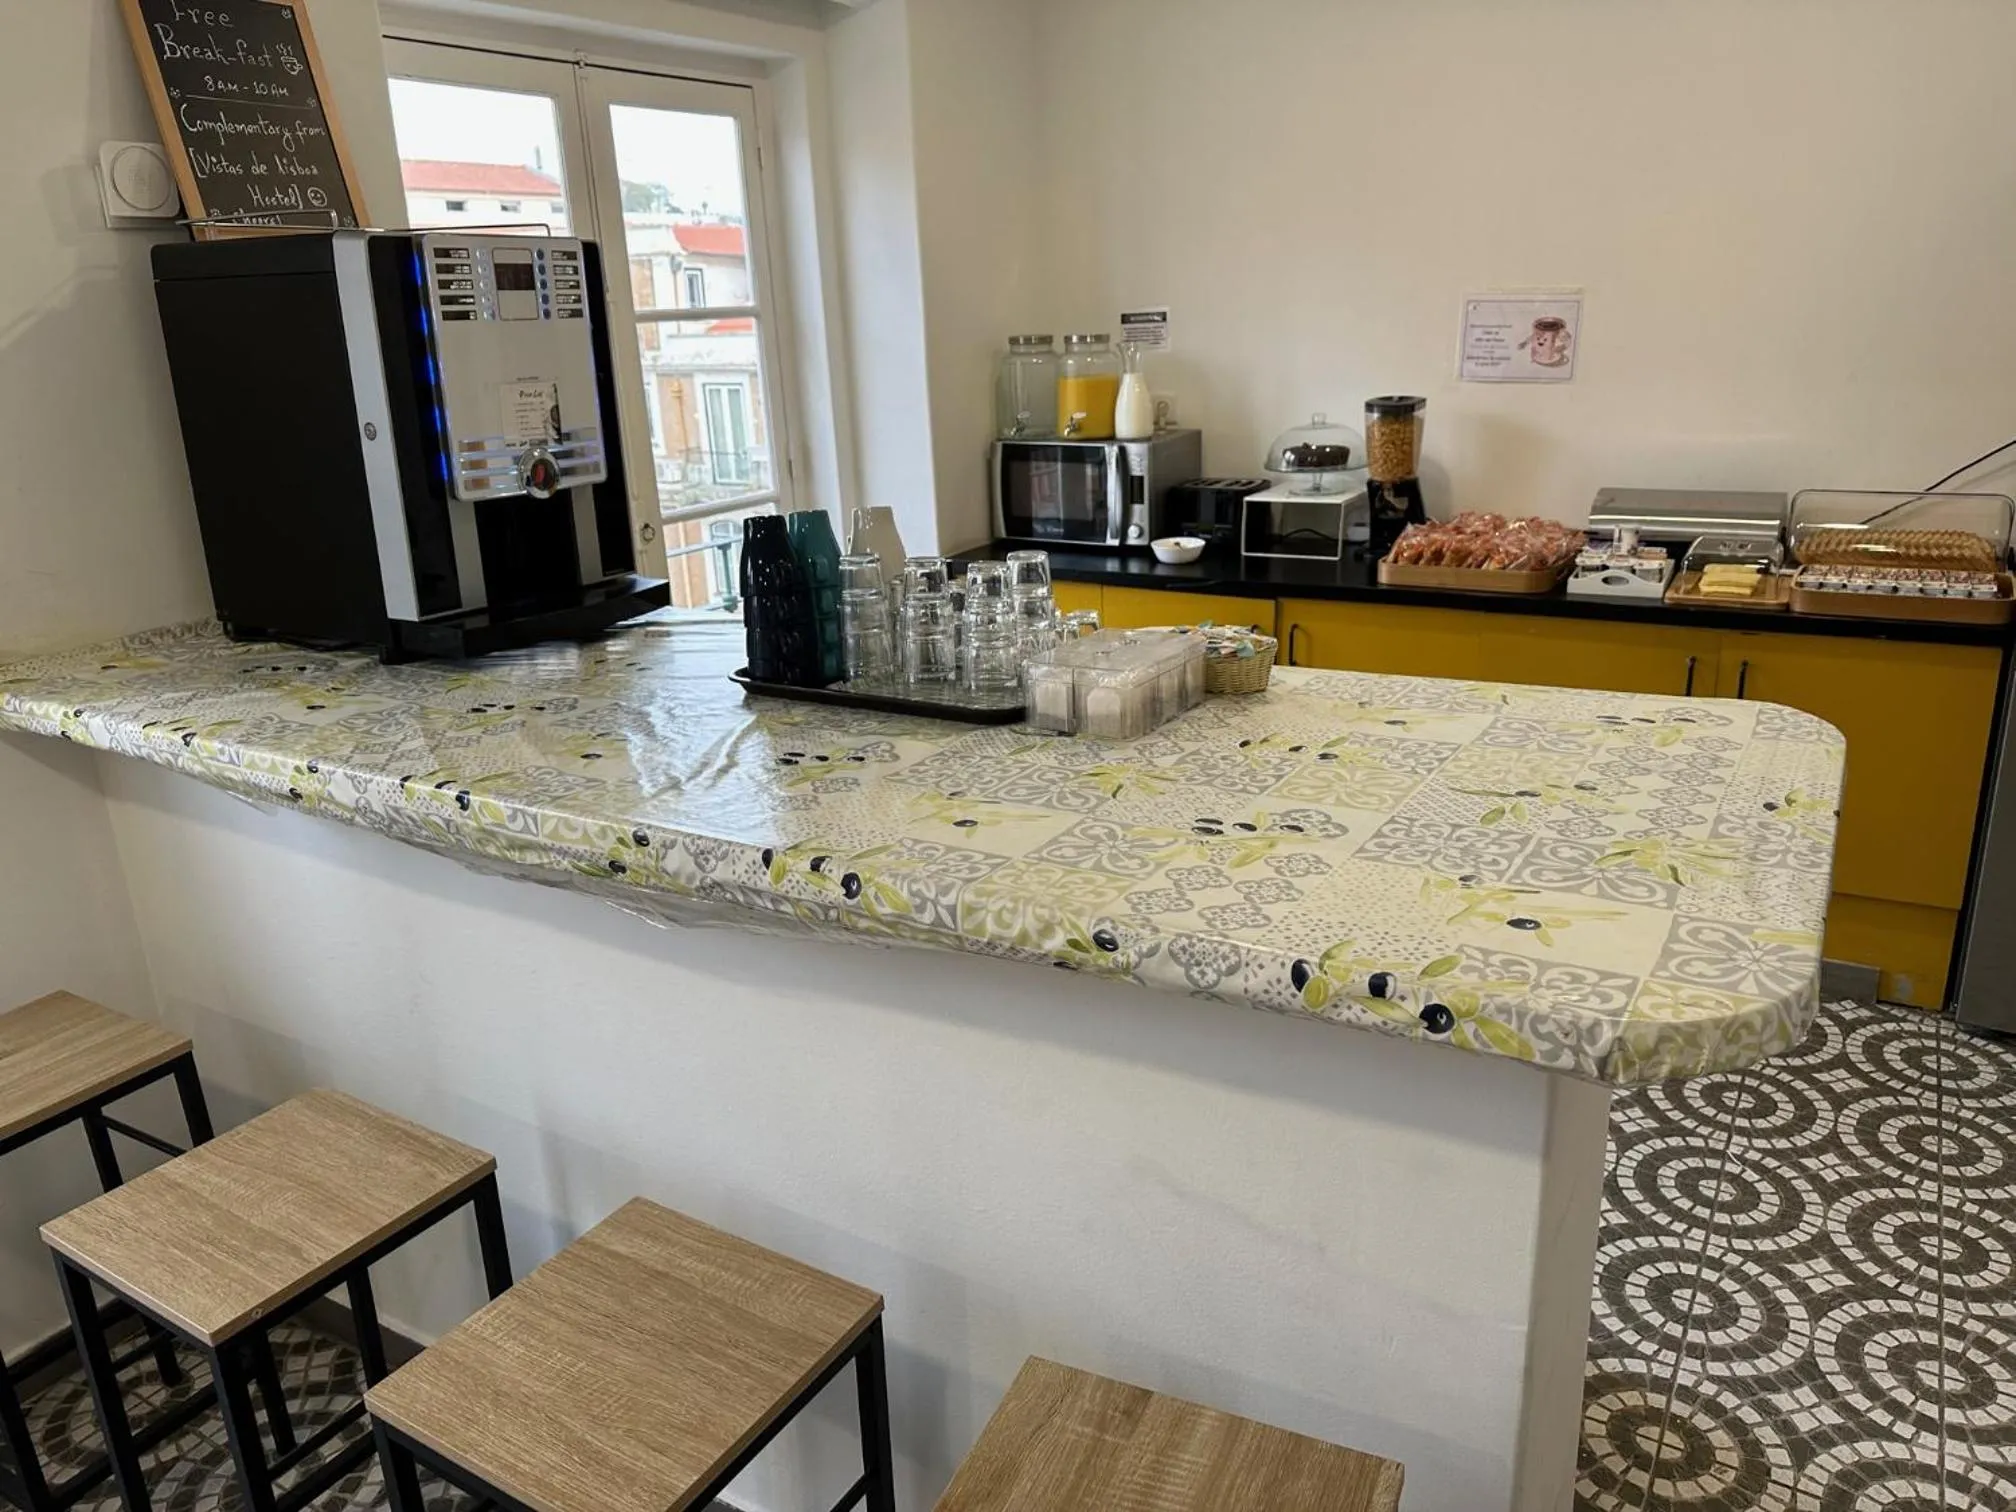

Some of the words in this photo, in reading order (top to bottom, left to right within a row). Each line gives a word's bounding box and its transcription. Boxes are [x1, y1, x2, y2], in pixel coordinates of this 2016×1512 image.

[170, 0, 234, 27] Free
[153, 22, 274, 68] Break-fast
[180, 103, 294, 152] Complementary
[294, 120, 326, 144] from
[250, 150, 269, 175] de
